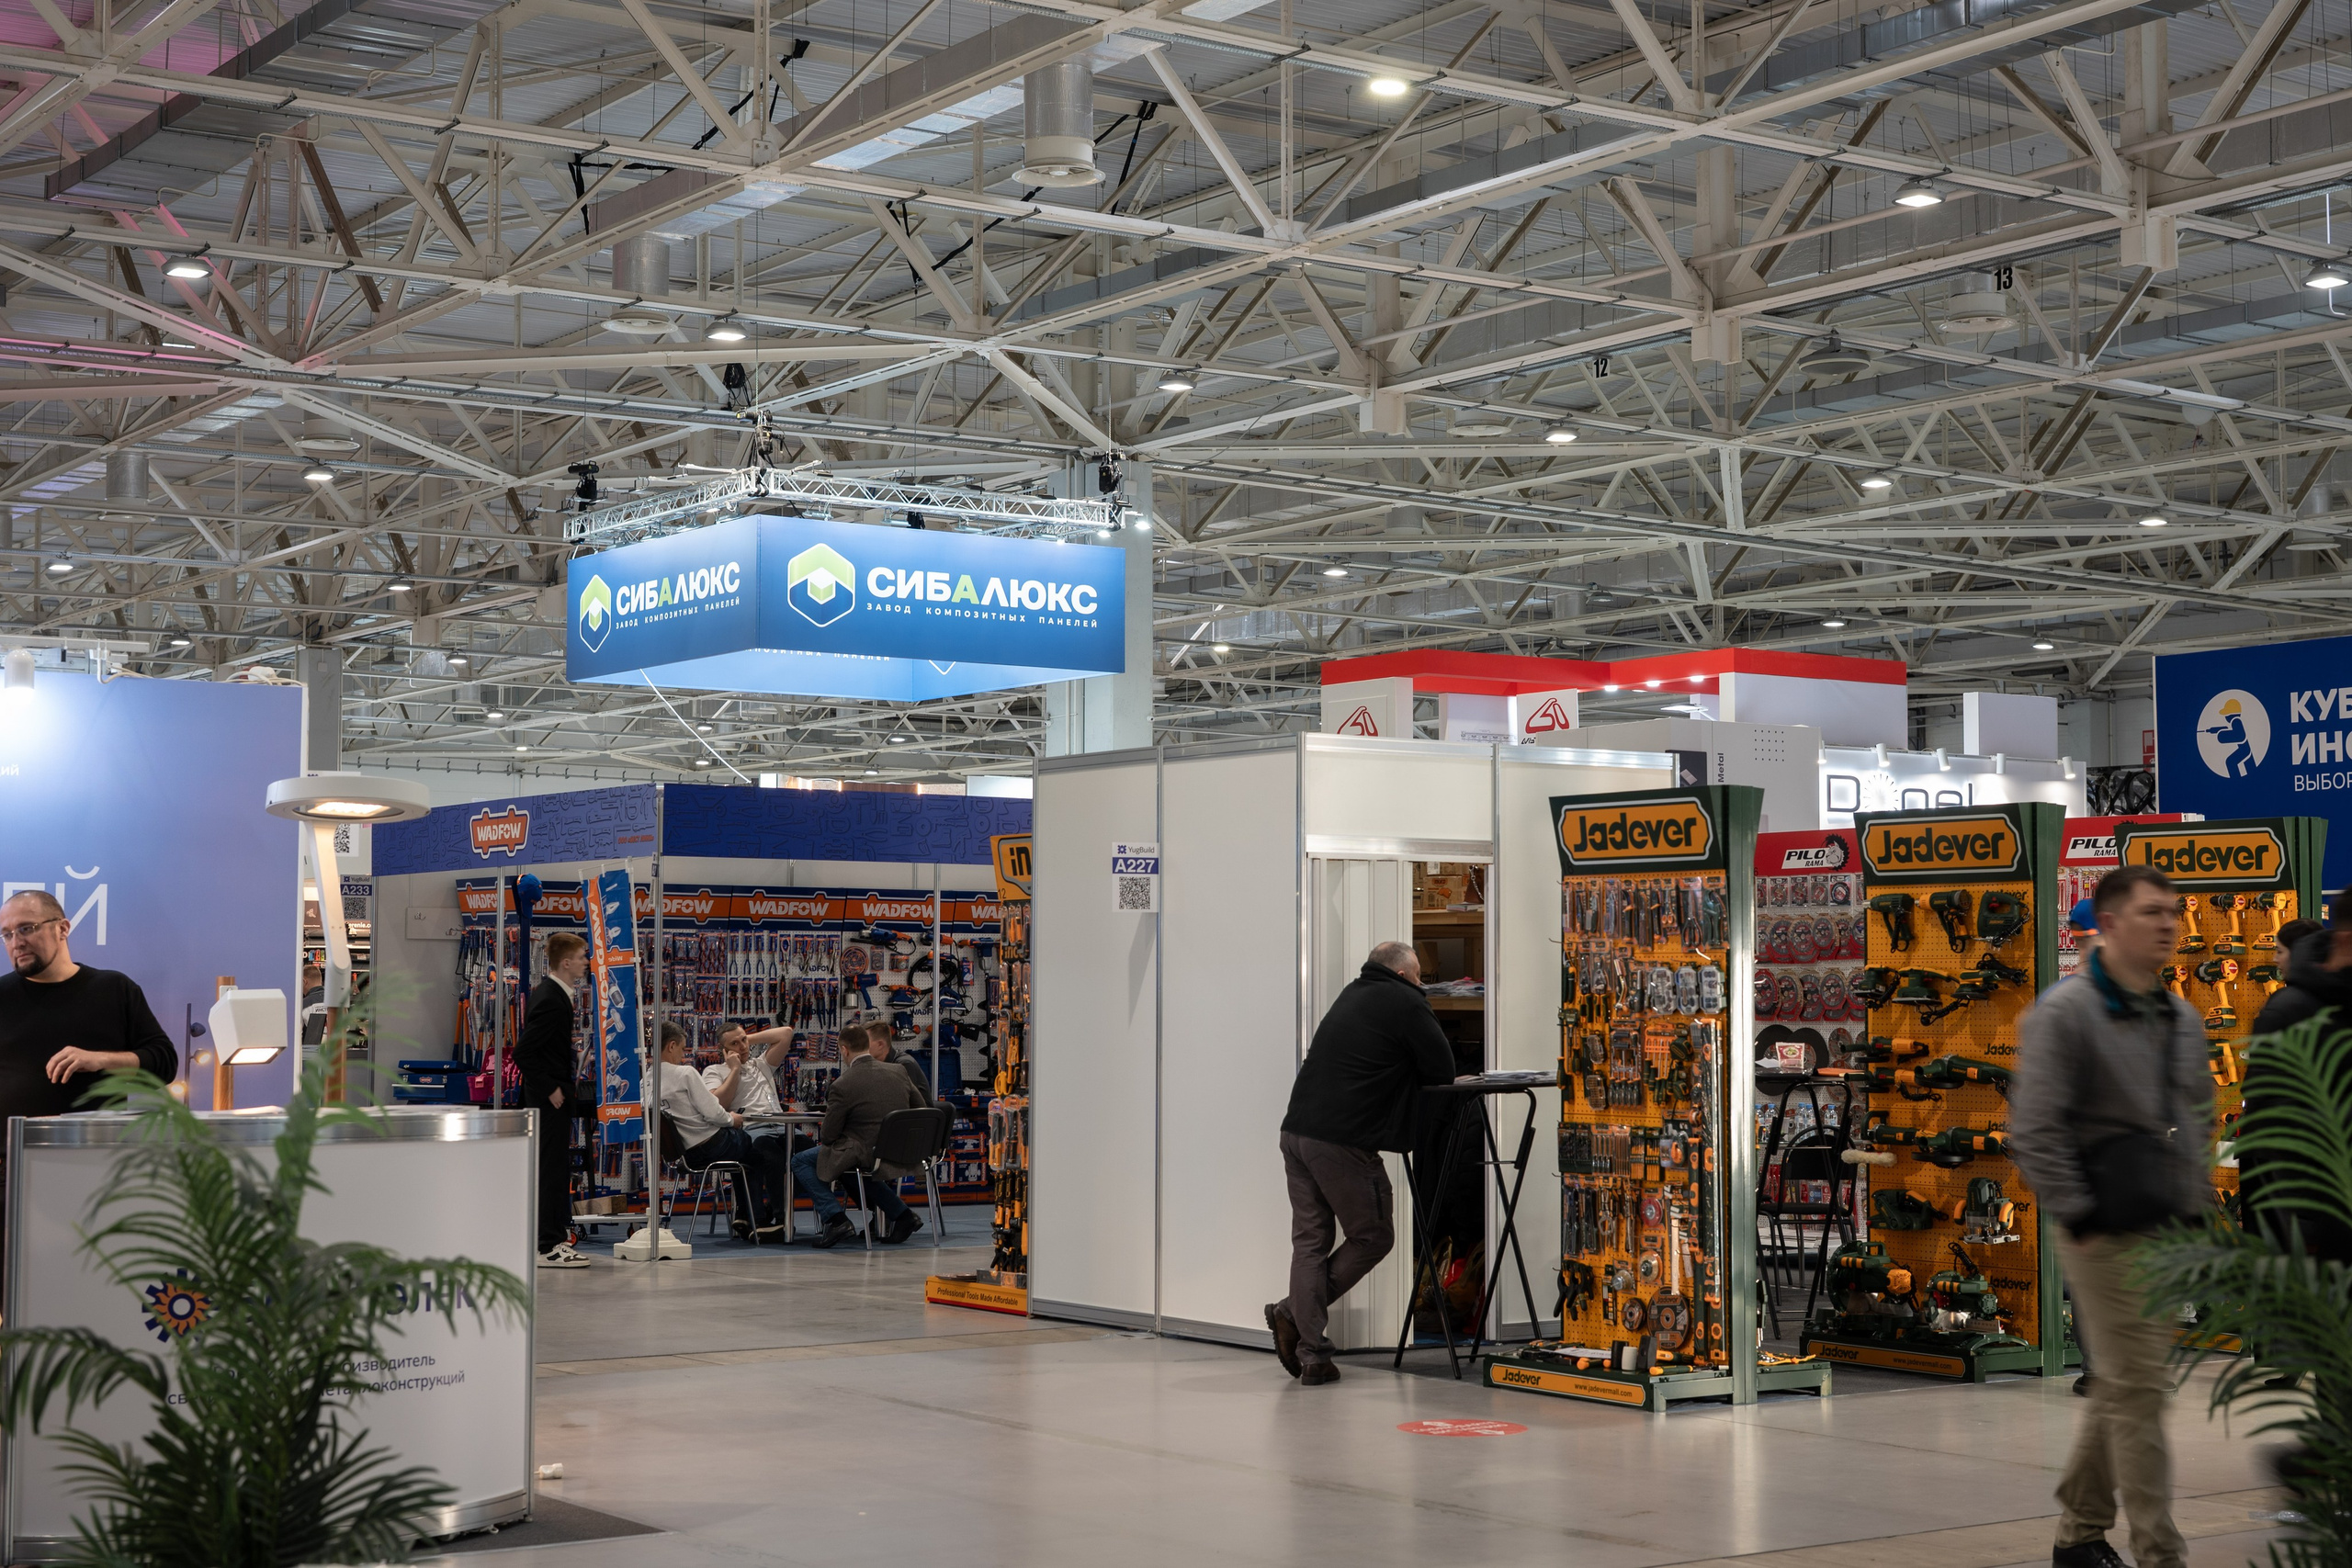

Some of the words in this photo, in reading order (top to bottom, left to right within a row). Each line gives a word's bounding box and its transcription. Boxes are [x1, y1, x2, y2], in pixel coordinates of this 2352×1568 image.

[1994, 266, 2014, 291] 13
[1594, 358, 1609, 379] 12
[616, 561, 741, 615] СИБАЛЮКС
[866, 566, 1098, 615] СИБАЛЮКС
[616, 618, 639, 629] ЗАВОД
[644, 605, 698, 624] КОМПОЗИТНЫХ
[705, 596, 741, 612] ПАНЕЛЕЙ
[866, 603, 911, 615] ЗАВОД
[926, 607, 1026, 623] КОМПОЗИТНЫХ
[1038, 616, 1098, 628] ПАНЕЛЕЙ
[477, 822, 522, 841] WADFOW
[1573, 812, 1697, 853] Jadever
[1785, 850, 1826, 861] PILO
[1877, 828, 2005, 864] Jadever
[2093, 849, 2117, 857] RAMA
[1114, 858, 1155, 873] A227
[341, 886, 369, 895] A233
[466, 894, 498, 908] WADFO
[748, 900, 830, 916] WADFOW
[936, 1287, 966, 1298] Professional
[966, 1291, 979, 1301] Tools
[979, 1293, 993, 1303] Made
[993, 1294, 1019, 1306] Affordable
[1819, 1344, 1860, 1360] Jadever
[323, 1355, 435, 1380] оизводитель
[1893, 1357, 1952, 1371] www.jadevermall.com
[1502, 1368, 1542, 1386] Jadever
[1574, 1382, 1633, 1397] www.jadevermall.com
